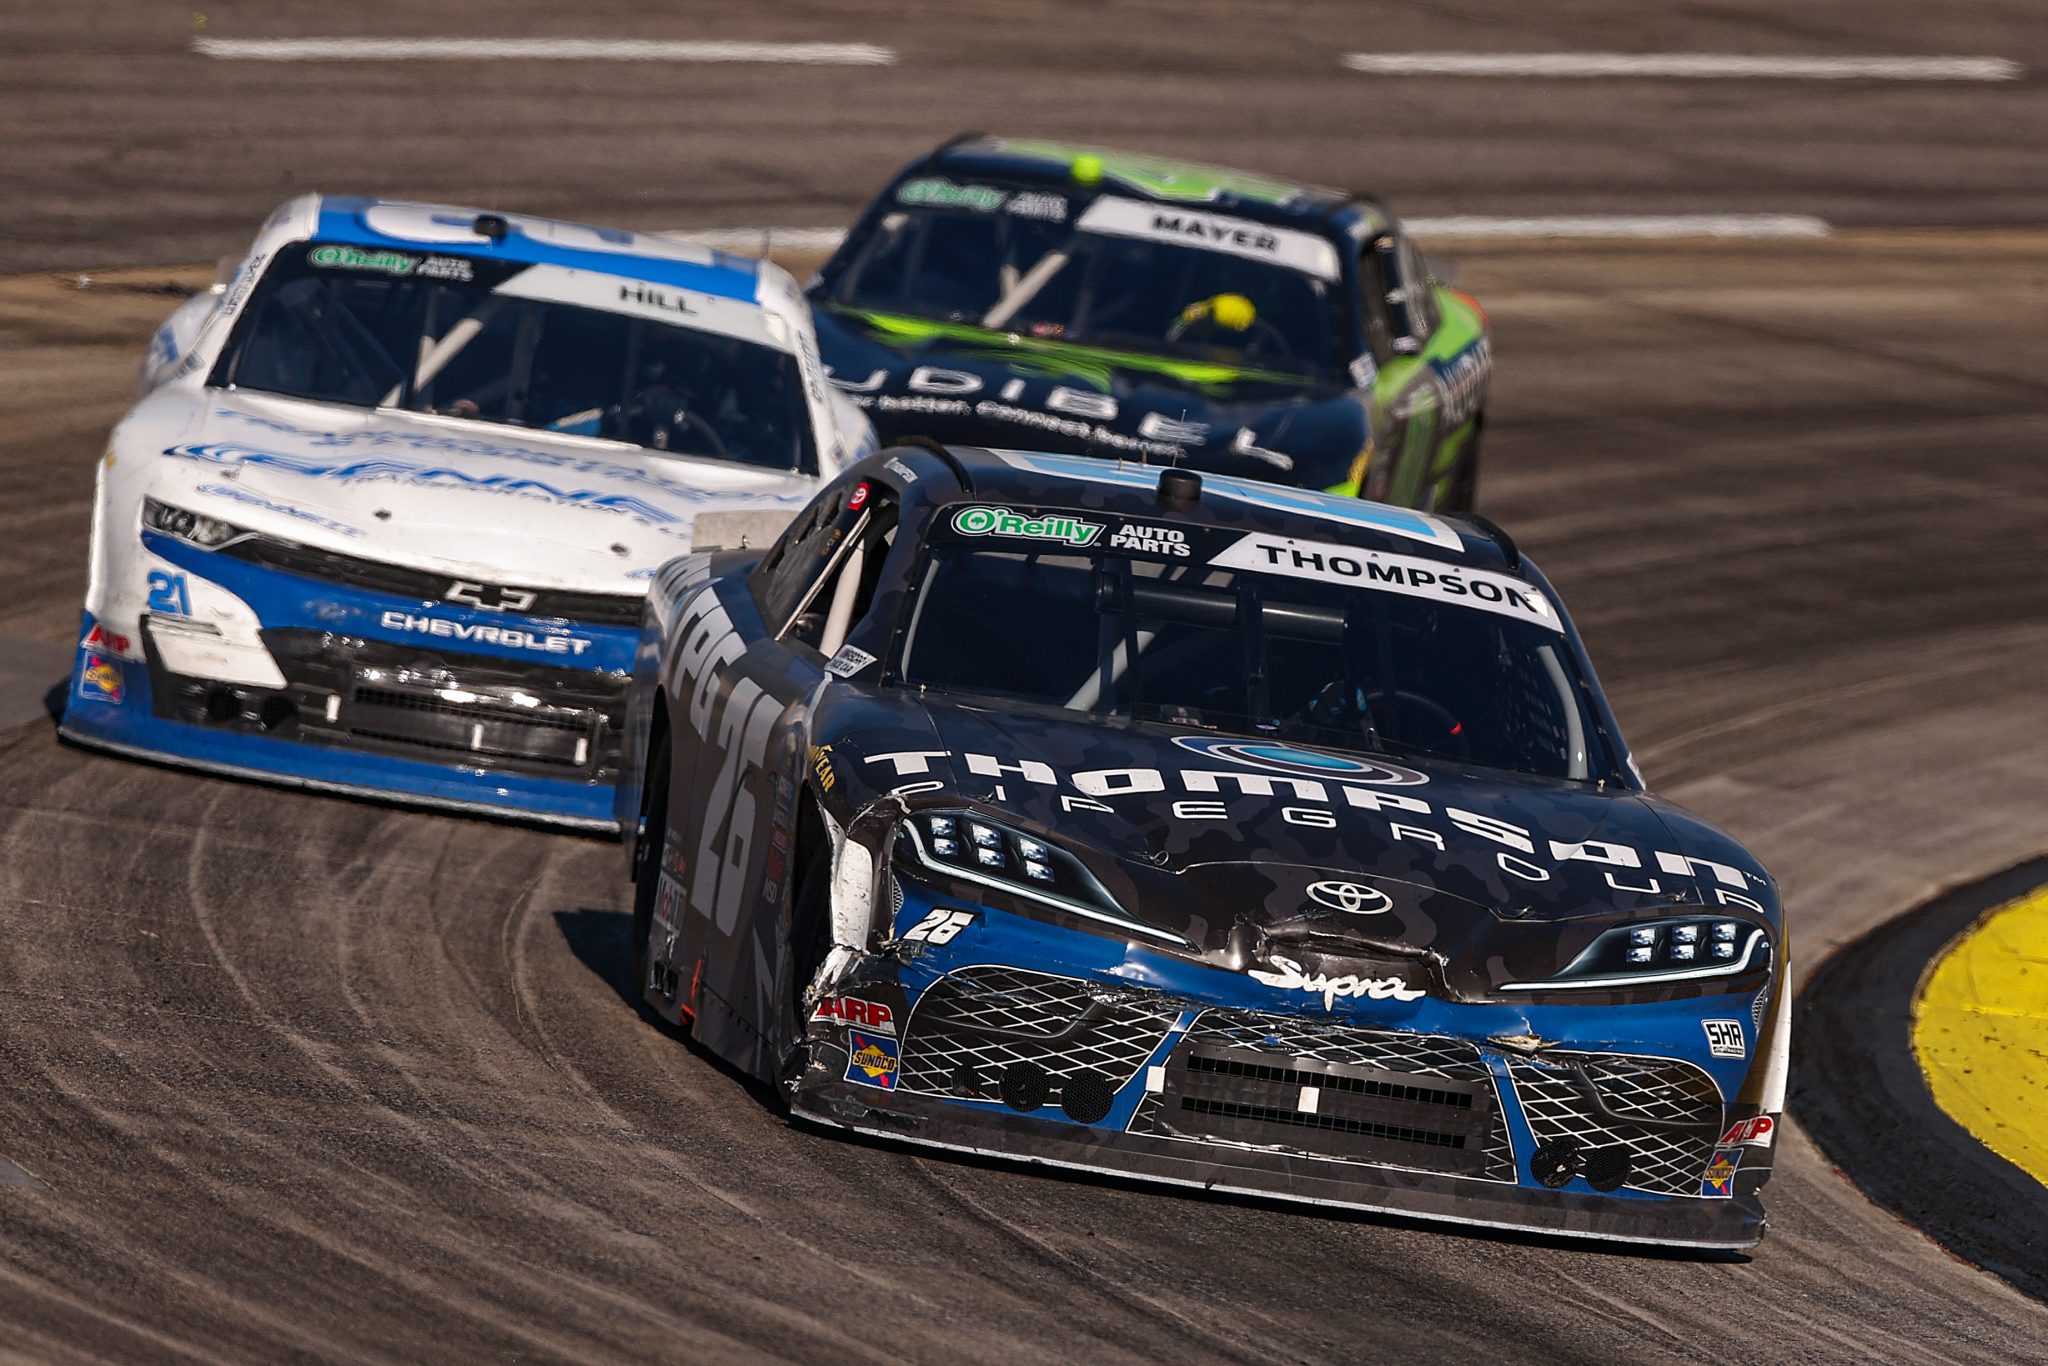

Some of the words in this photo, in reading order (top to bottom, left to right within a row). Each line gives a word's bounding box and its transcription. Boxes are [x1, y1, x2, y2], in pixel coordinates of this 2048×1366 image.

[1151, 213, 1279, 252] MAYER
[619, 285, 697, 316] HILL
[825, 364, 1294, 471] UDIBEL
[957, 507, 1095, 542] O'Reilly
[1119, 524, 1185, 543] AUTO
[1110, 534, 1191, 557] PARTS
[146, 570, 192, 617] 21
[1256, 543, 1539, 614] THOMPSON
[381, 611, 592, 655] CHEVROLET
[690, 676, 786, 938] 26
[864, 751, 1748, 891] THOMPSON
[1282, 806, 1766, 914] GROUP
[903, 909, 975, 945] 26
[1248, 955, 1427, 1012] Supra
[816, 996, 892, 1027] ARP
[1705, 1023, 1743, 1046] SHR
[854, 1051, 896, 1072] SUNOCO
[1706, 1167, 1733, 1182] SUNOCO
